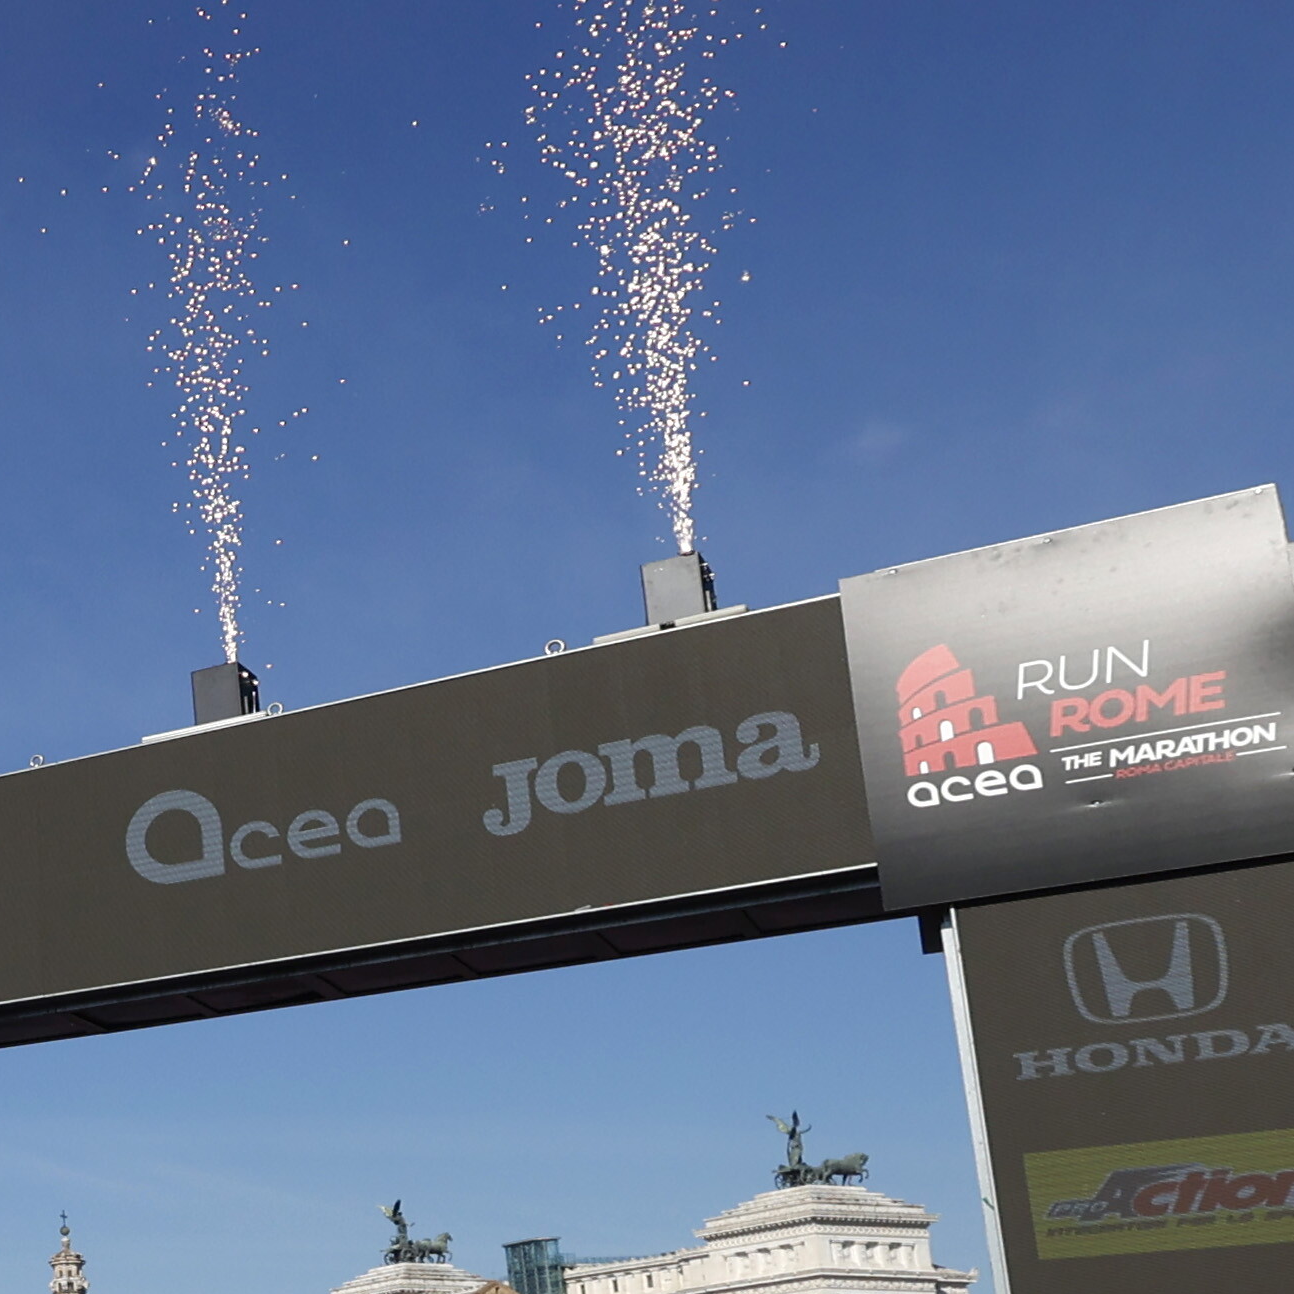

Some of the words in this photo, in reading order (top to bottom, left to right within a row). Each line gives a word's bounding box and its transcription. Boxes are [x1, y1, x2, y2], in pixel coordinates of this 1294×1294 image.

[1016, 639, 1149, 700] RUN
[1050, 670, 1226, 738] ROME
[1061, 751, 1103, 772] THE
[1108, 722, 1277, 768] MARATHON
[906, 763, 1044, 808] acea
[1013, 1022, 1294, 1081] HONDA
